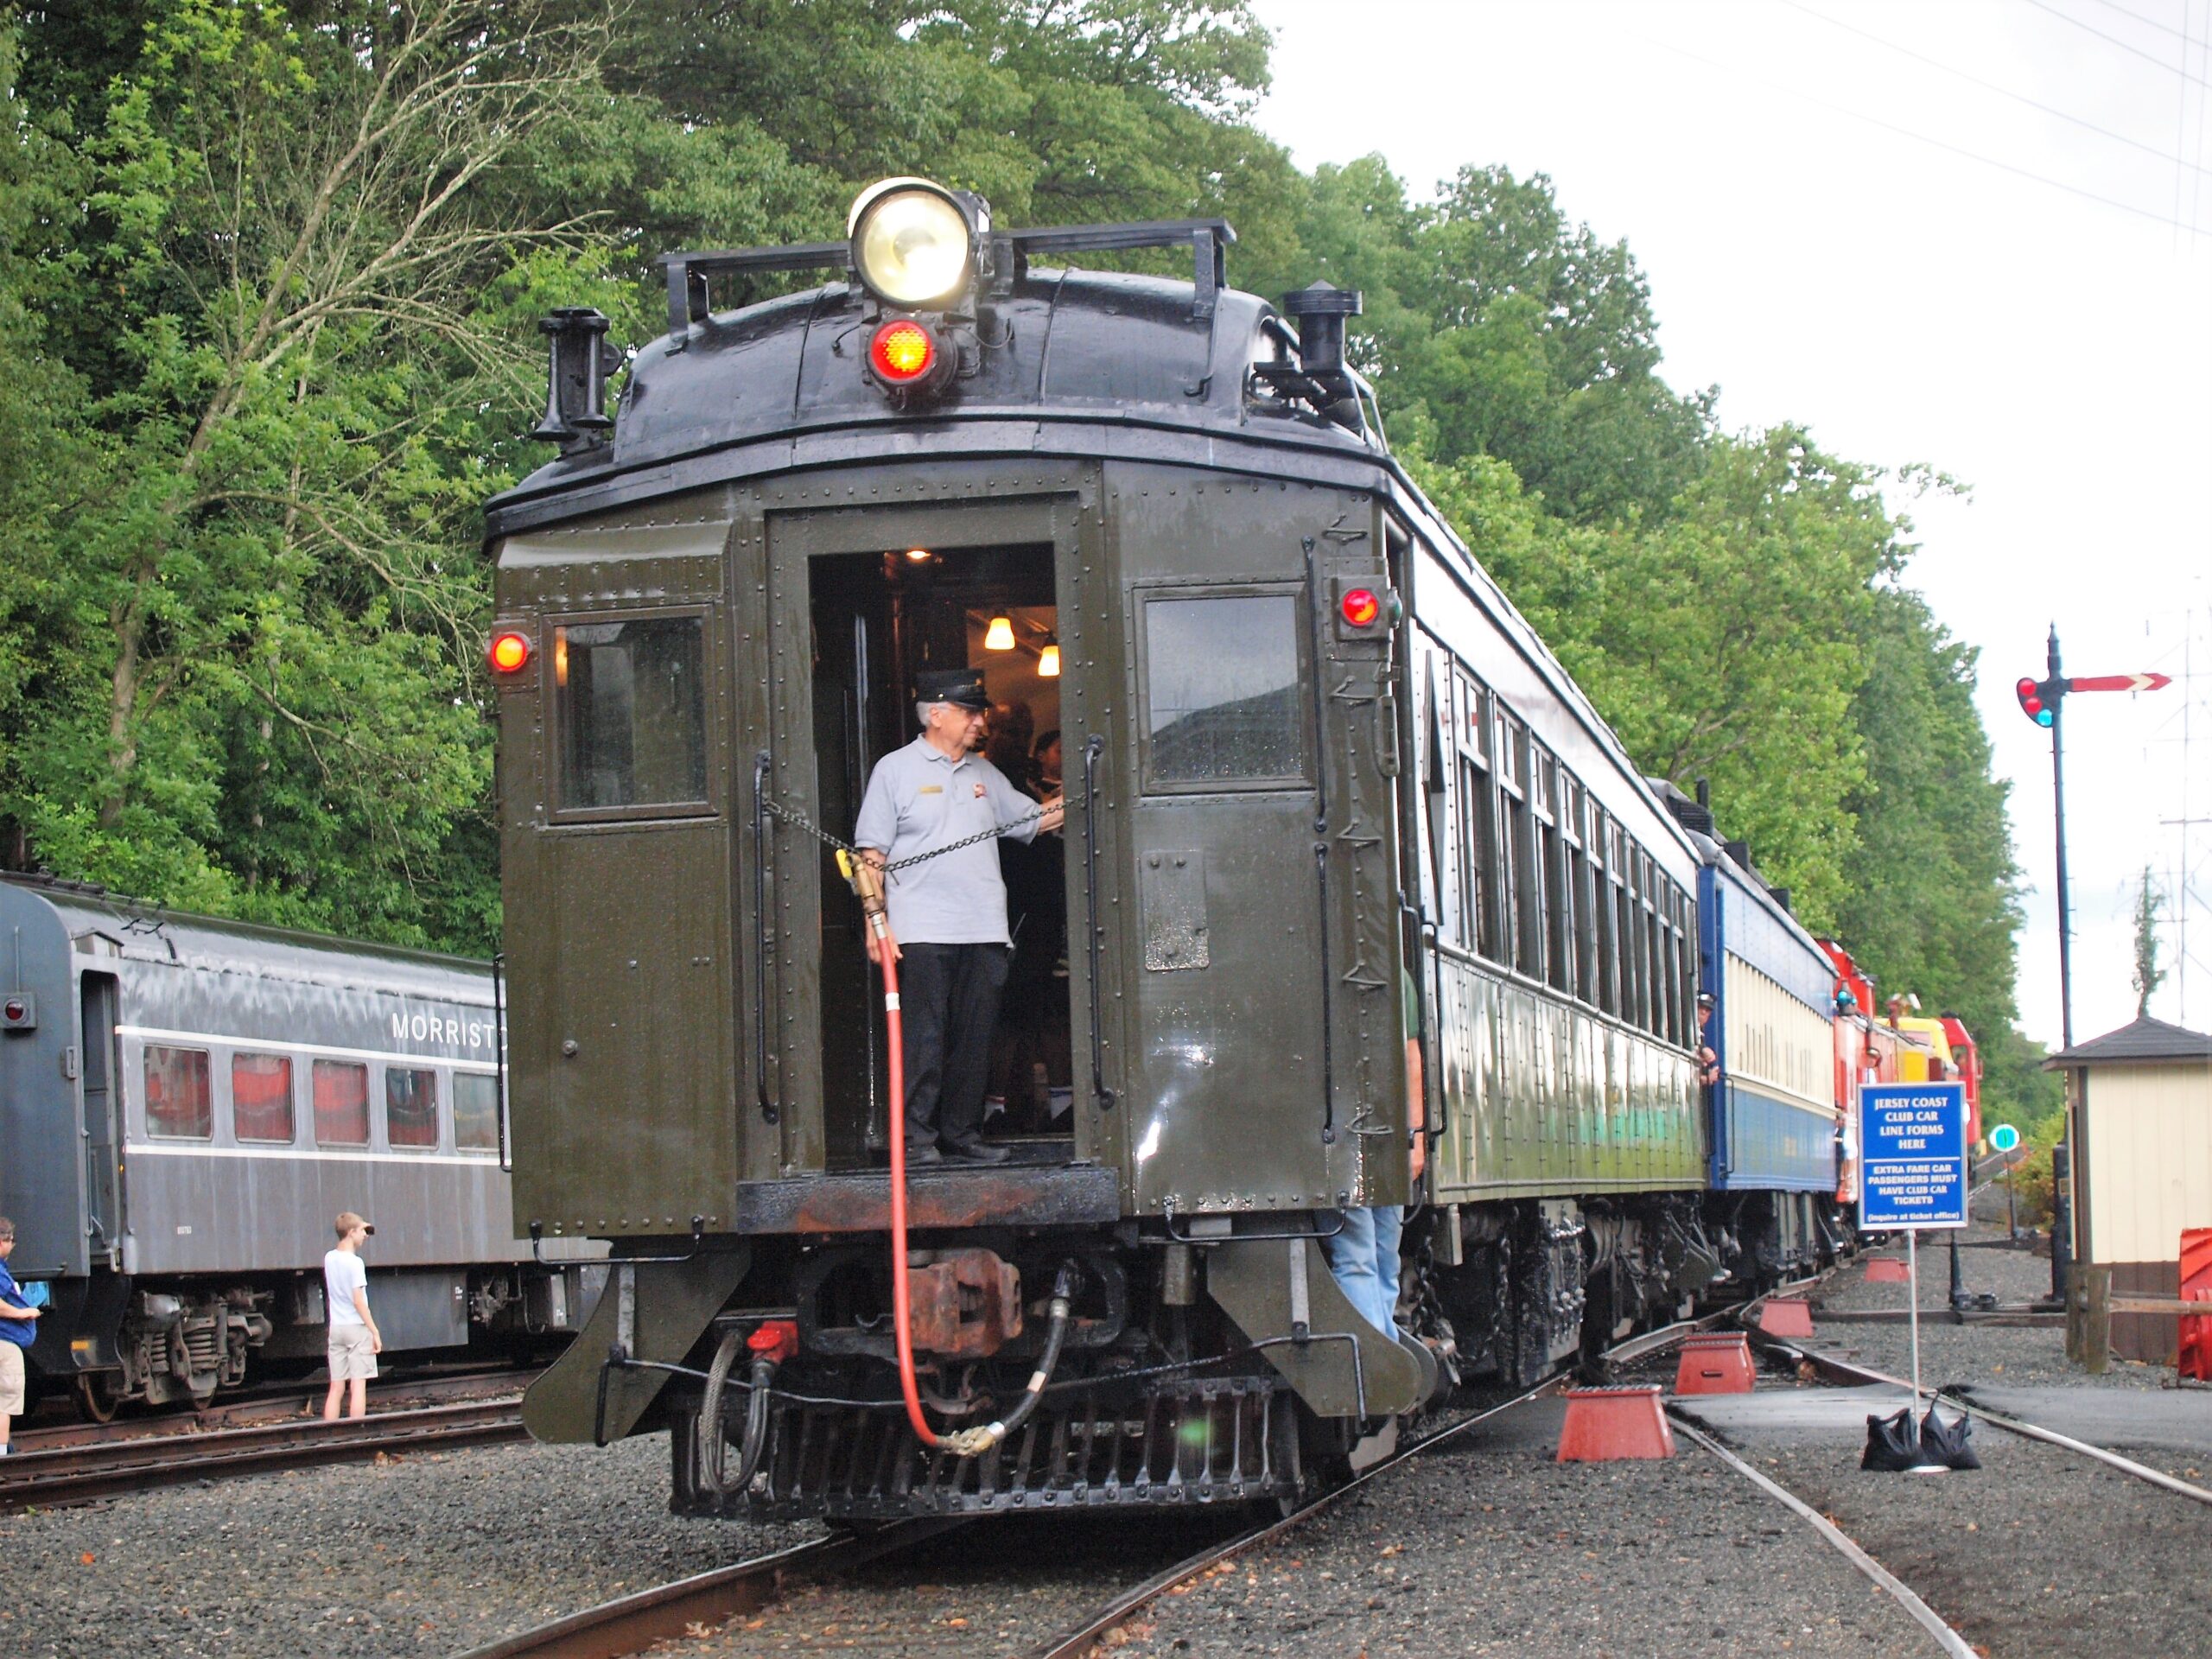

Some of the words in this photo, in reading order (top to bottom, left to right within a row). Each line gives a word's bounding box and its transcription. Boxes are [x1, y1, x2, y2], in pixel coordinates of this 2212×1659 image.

[1875, 1098, 1910, 1110] JERSEY
[1912, 1097, 1948, 1108] COAST
[1885, 1112, 1914, 1122] CLUB
[1916, 1111, 1938, 1122] CAR
[1879, 1126, 1904, 1136] LINE
[1907, 1125, 1943, 1135] FORMS
[1897, 1139, 1926, 1149] HERE
[1873, 1166, 1904, 1174] EXTRA
[1906, 1165, 1930, 1173] FARE
[1931, 1164, 1952, 1173] CAR
[1868, 1175, 1929, 1185] PASSENGERS
[1931, 1174, 1958, 1183] MUST
[1878, 1186, 1904, 1195] HAVE
[1930, 1185, 1948, 1194] CAR
[1893, 1196, 1934, 1205] TICKETS
